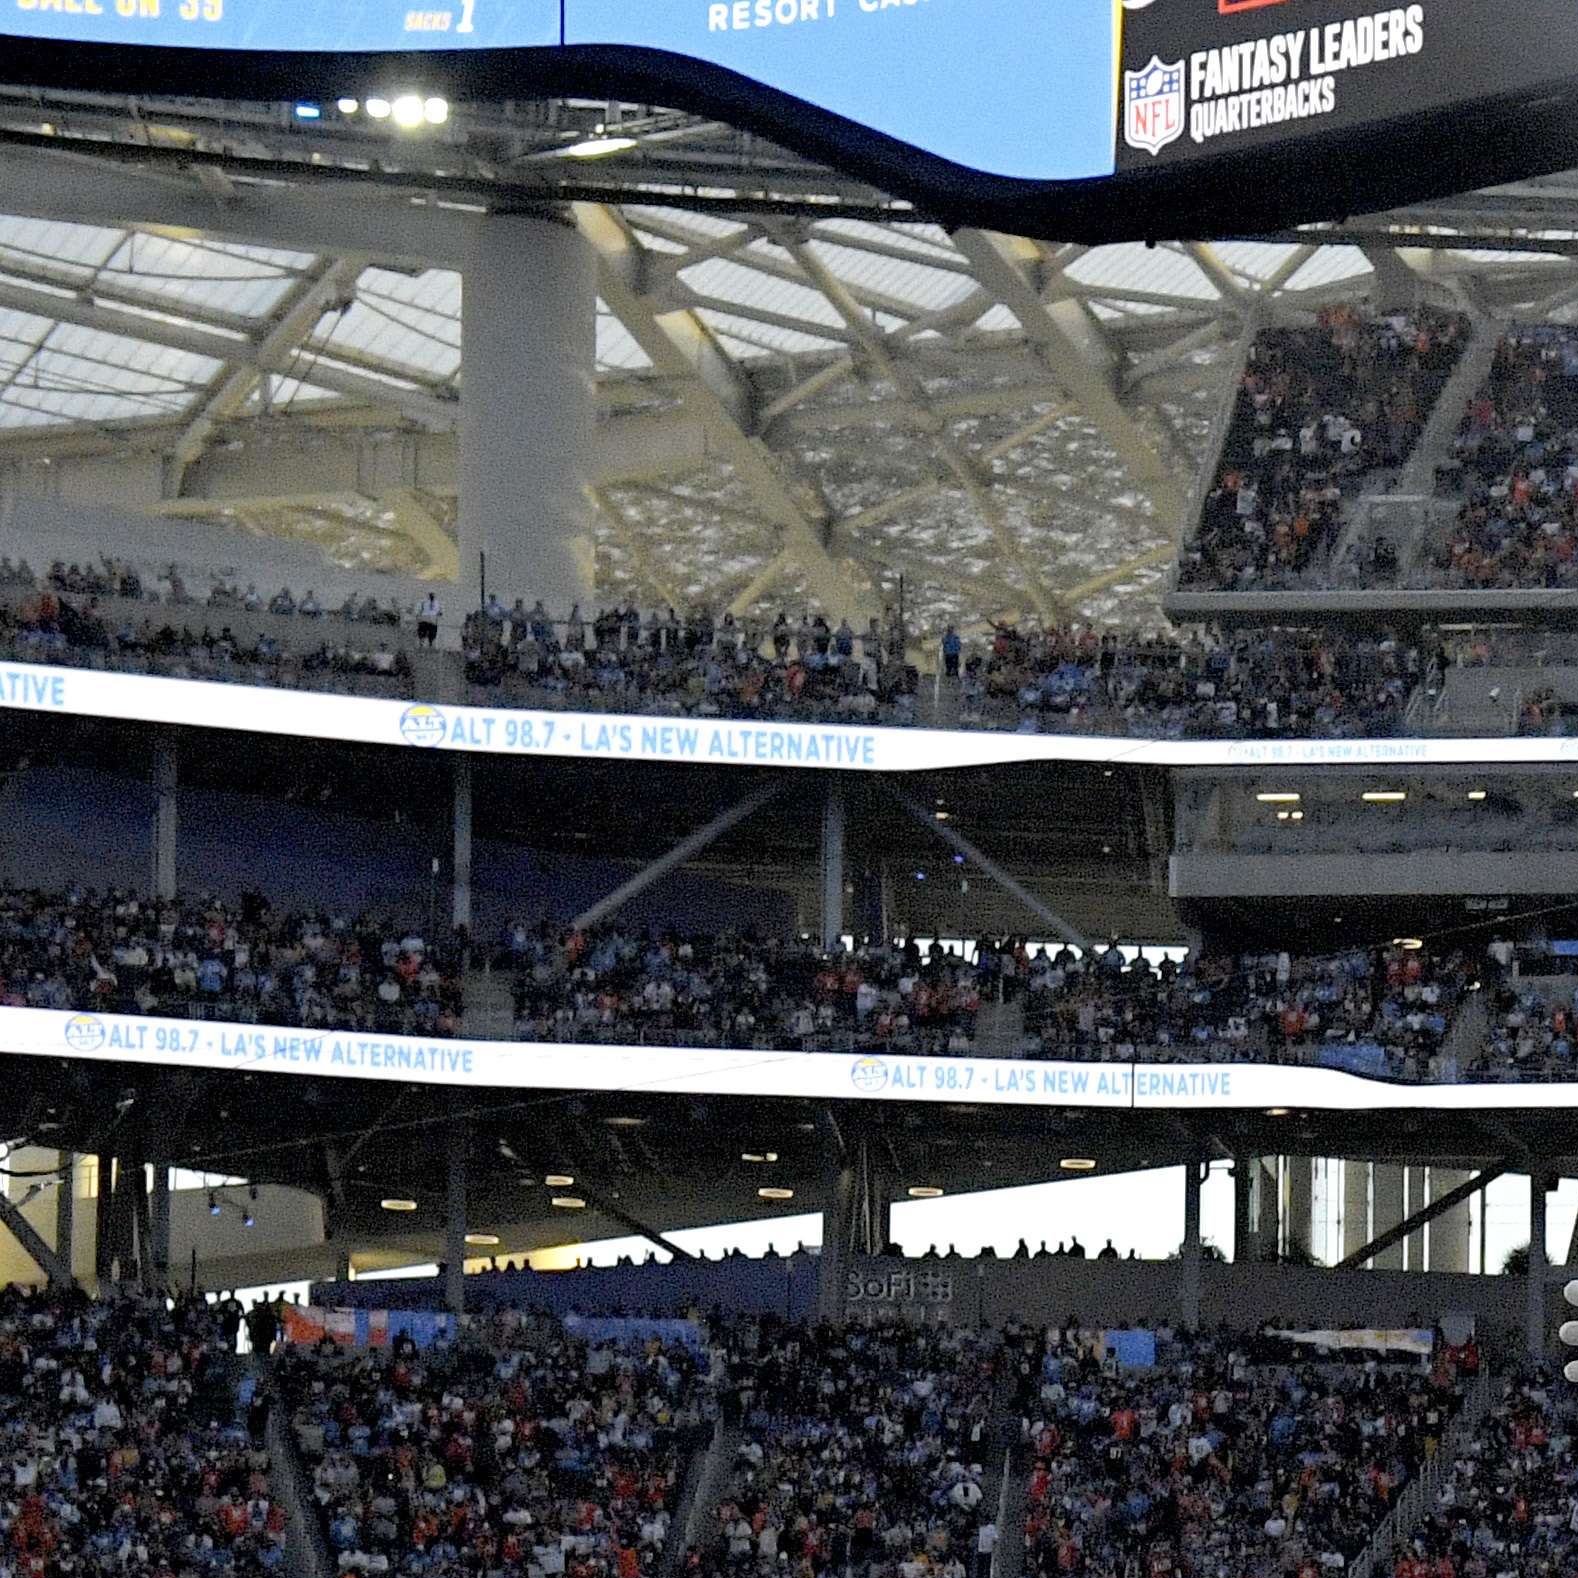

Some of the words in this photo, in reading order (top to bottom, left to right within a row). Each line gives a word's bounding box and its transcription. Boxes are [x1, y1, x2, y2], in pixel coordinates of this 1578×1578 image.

[1190, 32, 1305, 101] FANTASY
[1309, 4, 1424, 76] LEADERS
[1133, 97, 1179, 138] NFL
[1190, 75, 1335, 143] QUARTERBACKS
[450, 714, 496, 744] ALT
[504, 718, 554, 747] 98.7
[580, 722, 632, 751] LA'S
[640, 725, 700, 755] NEW
[708, 728, 876, 762] ALTERNATIVE
[107, 1024, 148, 1049] ALT
[154, 1027, 199, 1053] 98.7
[220, 1032, 265, 1058] LA'S
[273, 1036, 322, 1062] NEW
[330, 1040, 472, 1072] ALTERNATIVE
[890, 1065, 926, 1088] ALT
[934, 1067, 974, 1090] 98.7
[994, 1069, 1036, 1092] LA'S
[1042, 1070, 1088, 1093] NEW
[1096, 1072, 1230, 1095] ALTERNATIVE
